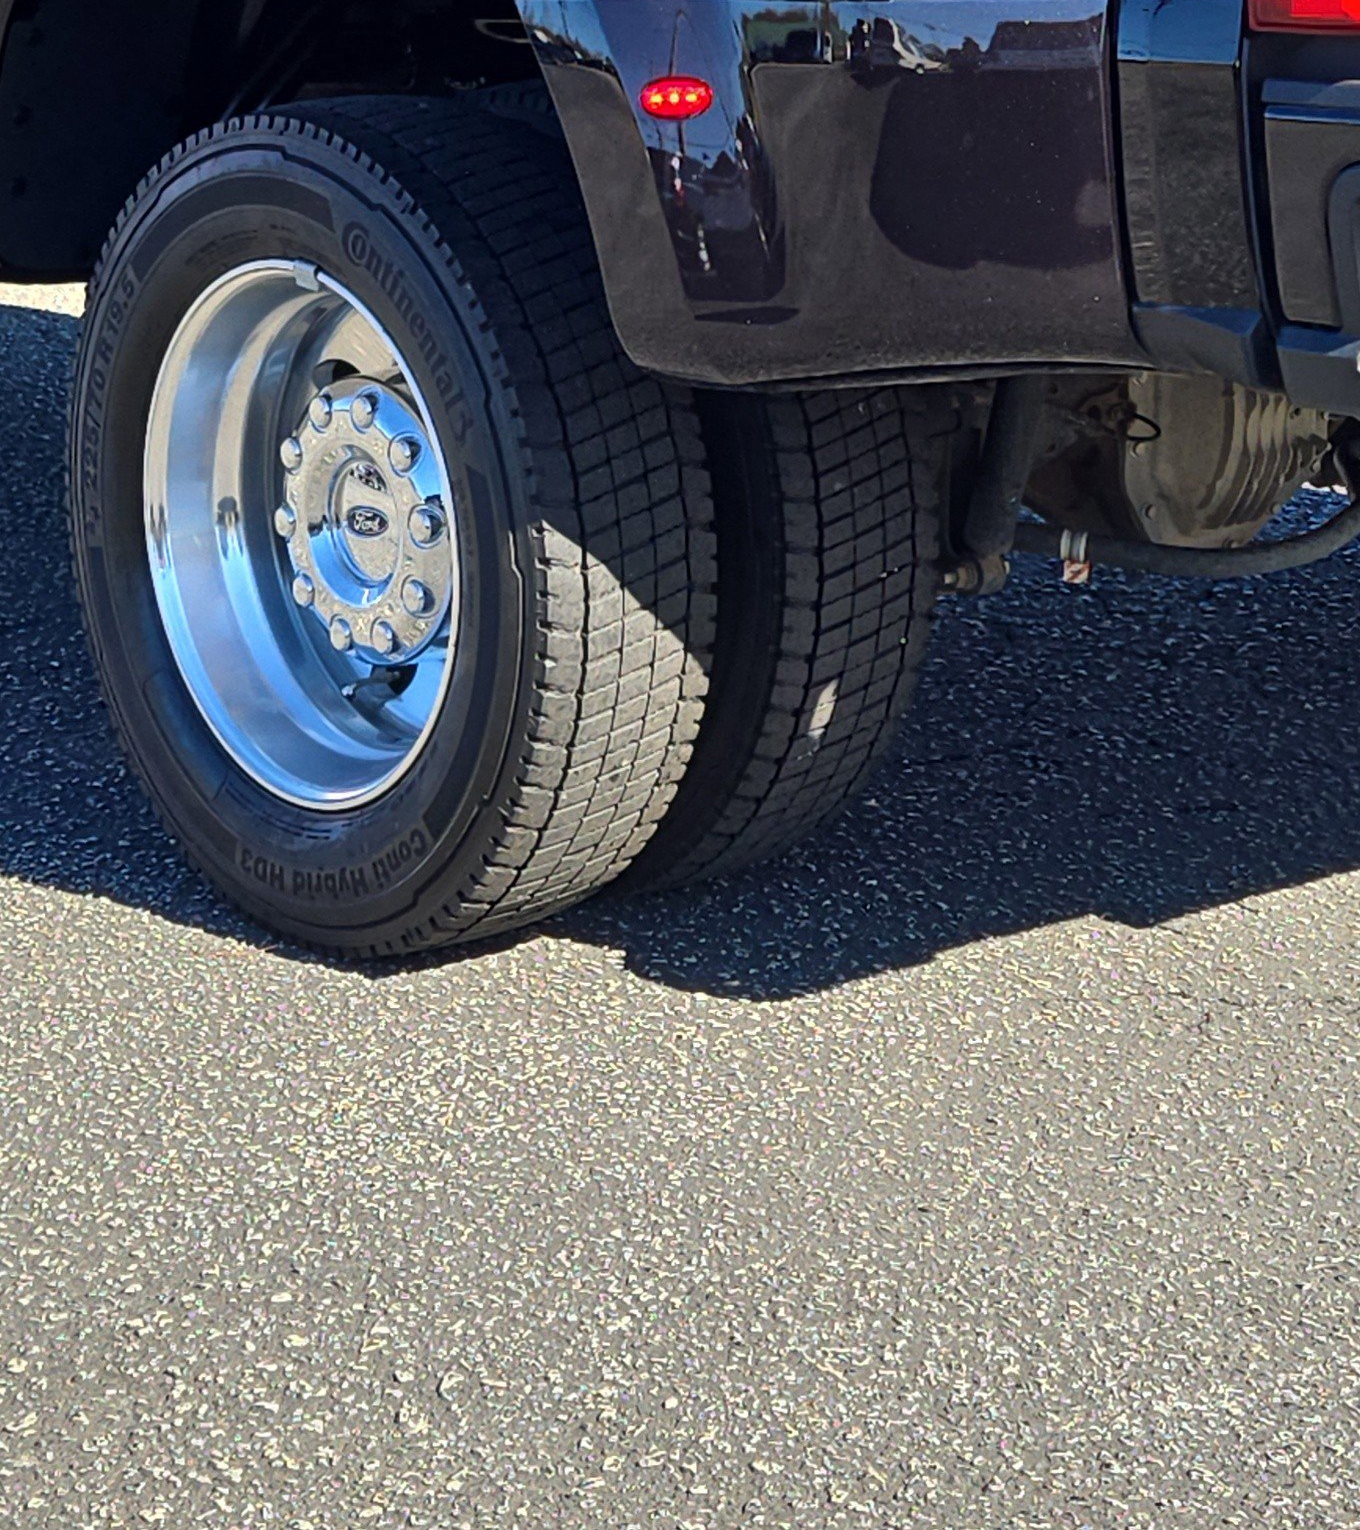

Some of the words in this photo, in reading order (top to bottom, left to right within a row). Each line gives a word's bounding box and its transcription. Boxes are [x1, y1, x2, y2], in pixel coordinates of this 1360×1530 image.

[342, 221, 466, 411] Continental
[240, 847, 286, 891] HD3
[293, 867, 370, 899] Hybrid
[372, 827, 428, 890] Conti
